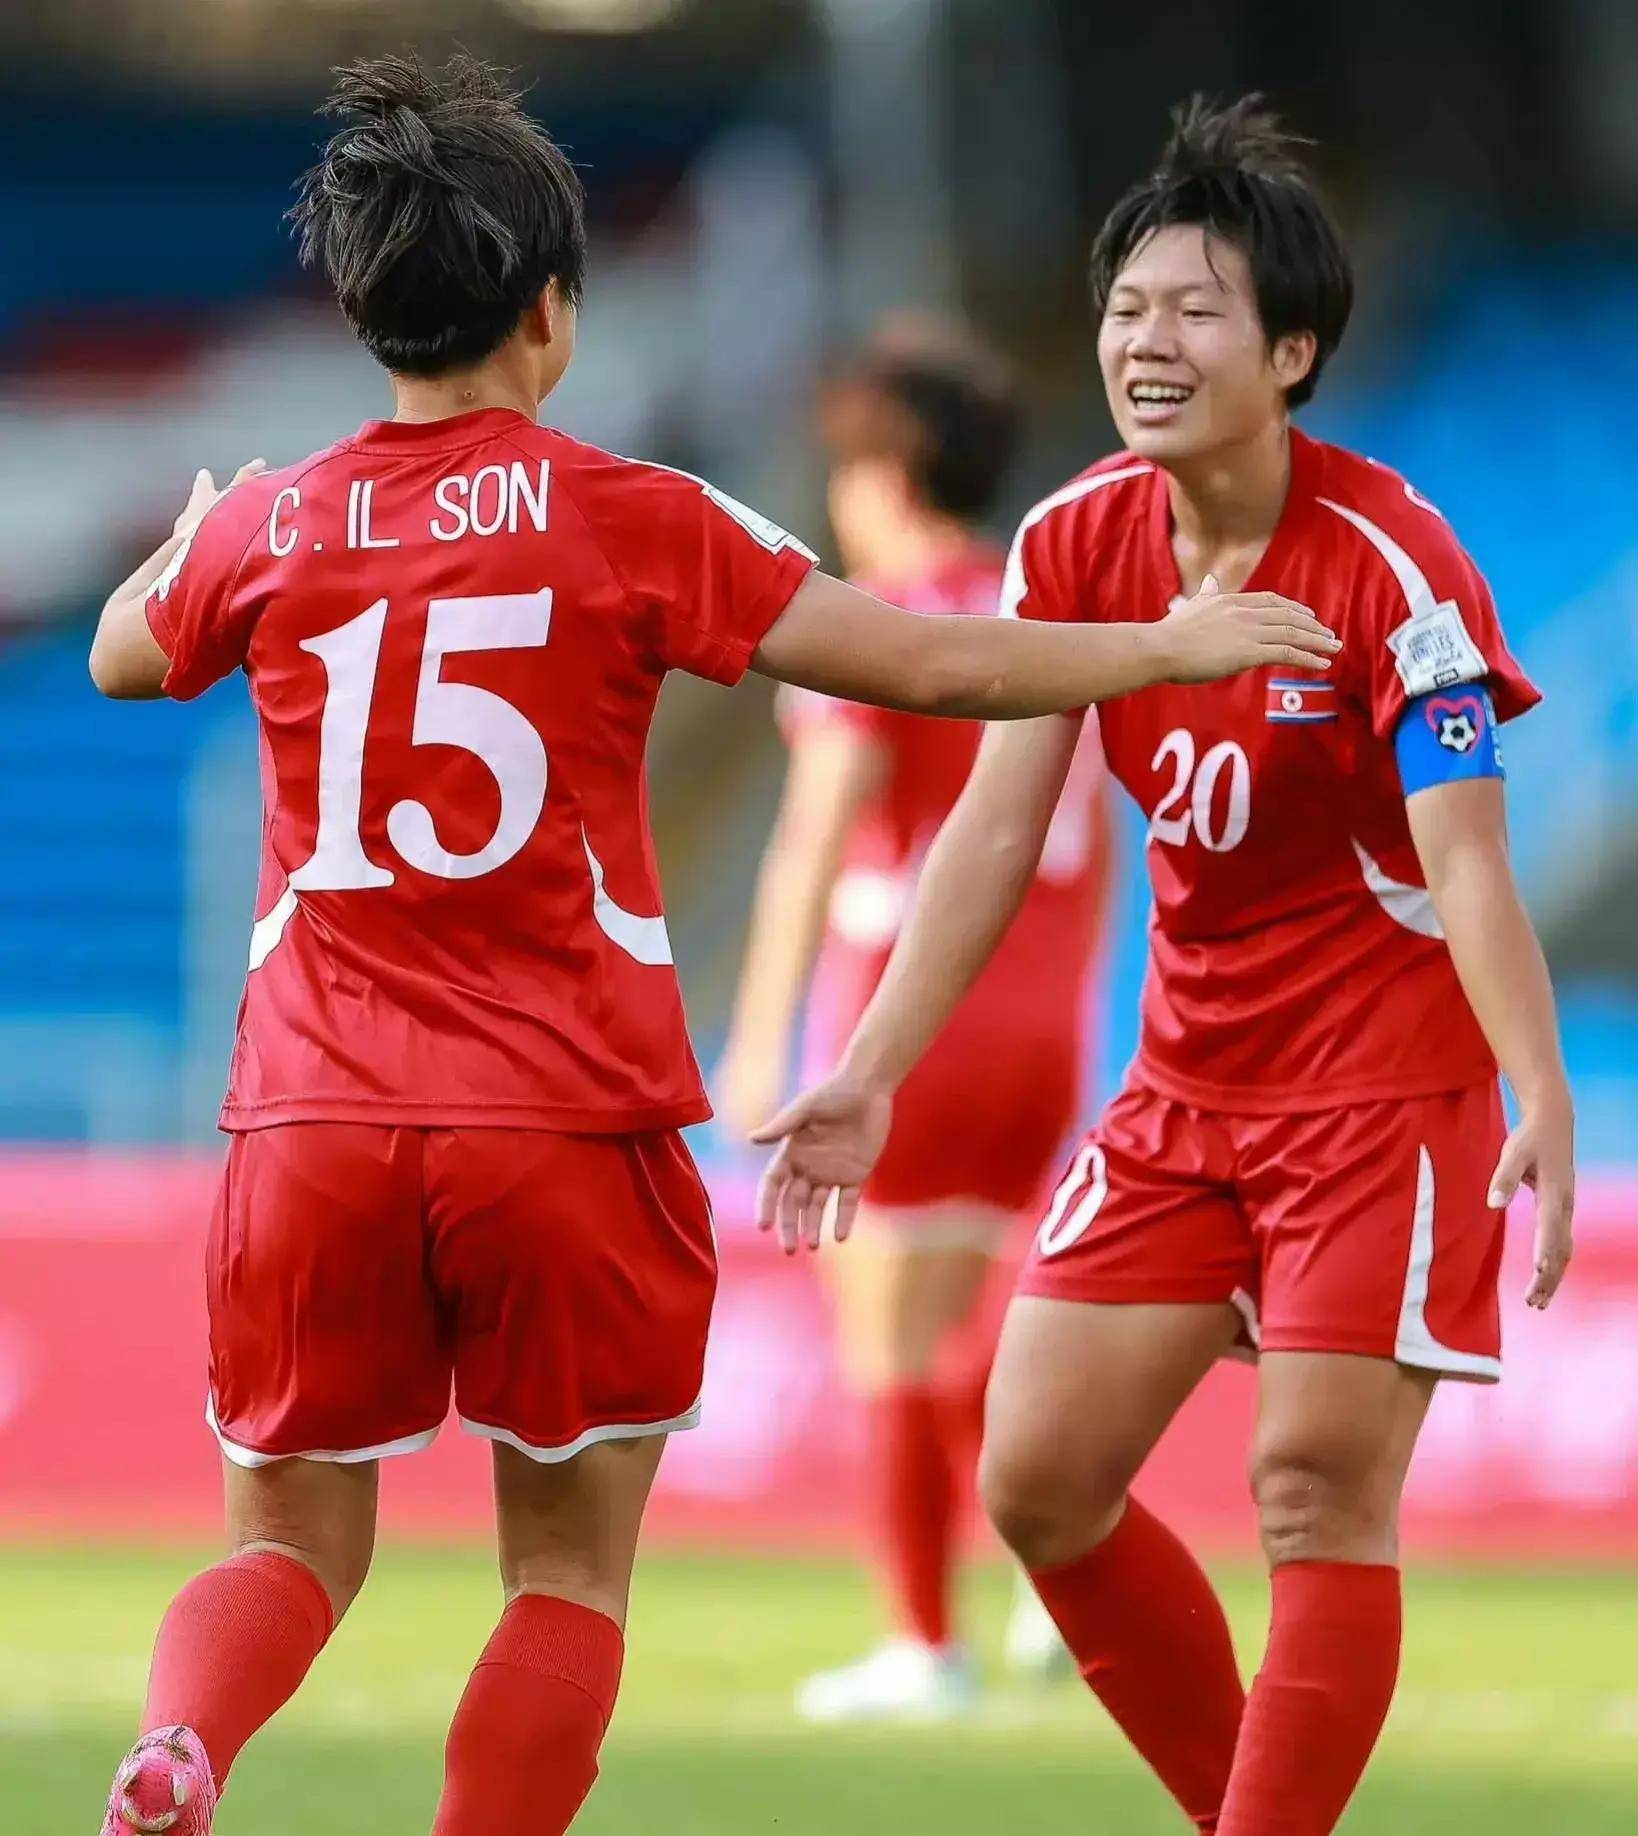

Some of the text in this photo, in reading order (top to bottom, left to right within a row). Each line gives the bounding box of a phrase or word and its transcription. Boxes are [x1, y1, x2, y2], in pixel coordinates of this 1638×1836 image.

[346, 480, 400, 550] IL
[428, 459, 551, 543] SON
[287, 586, 553, 891] 15
[1149, 728, 1250, 852] 20
